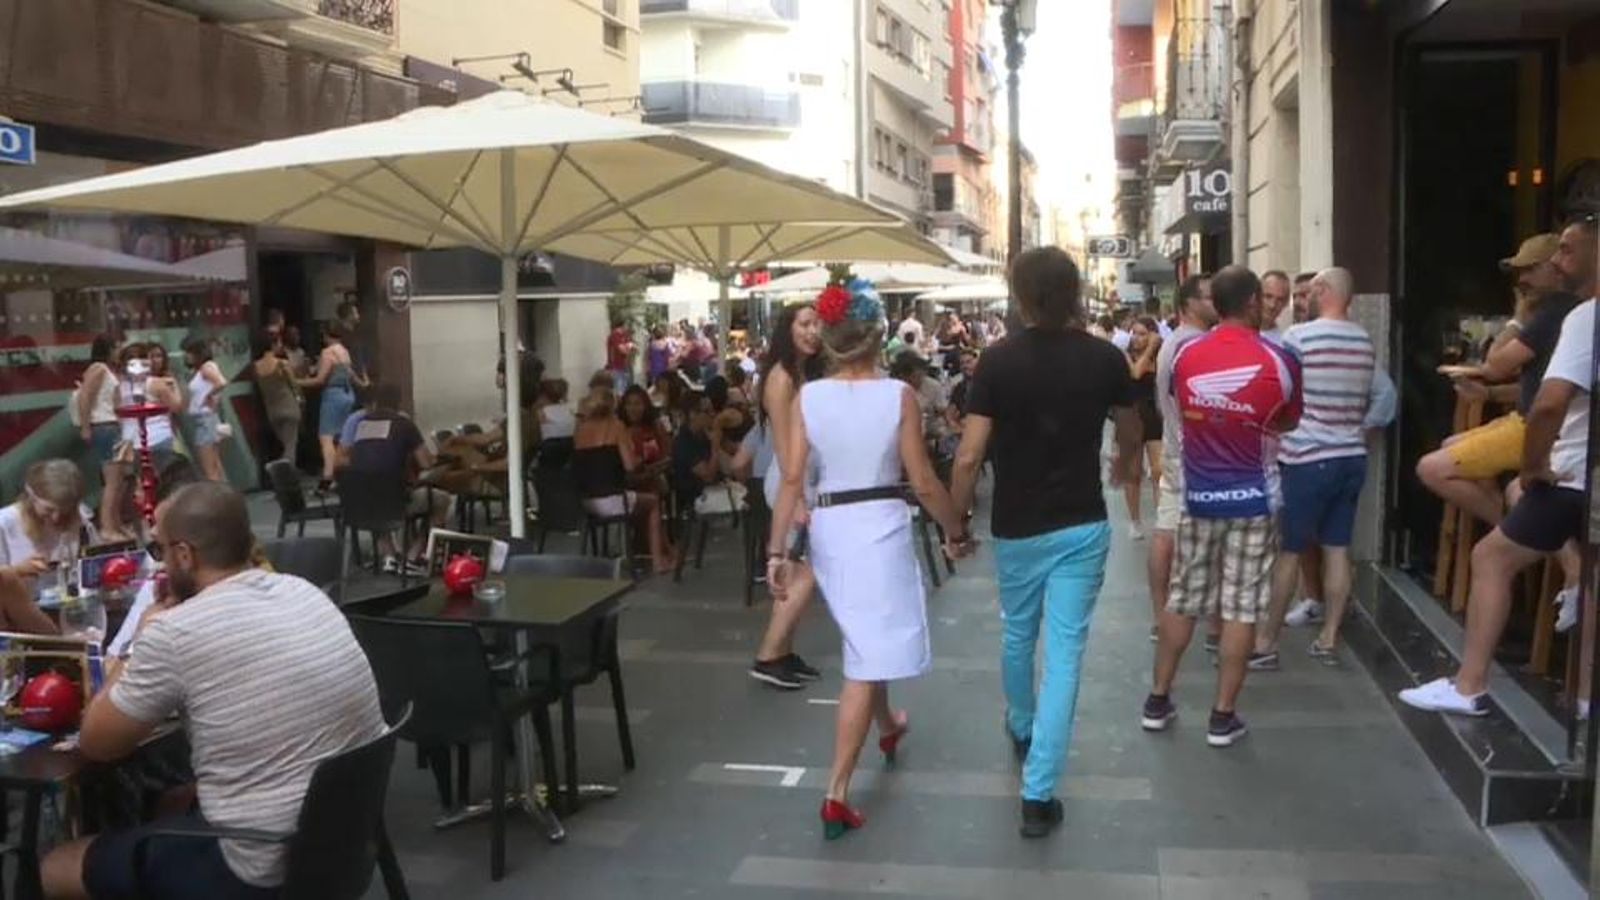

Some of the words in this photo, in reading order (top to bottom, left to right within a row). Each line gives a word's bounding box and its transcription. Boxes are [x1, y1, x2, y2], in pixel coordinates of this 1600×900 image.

[1186, 168, 1230, 197] 10
[1193, 197, 1228, 212] café
[1188, 395, 1257, 414] HONDA
[1188, 486, 1265, 504] HONDA
